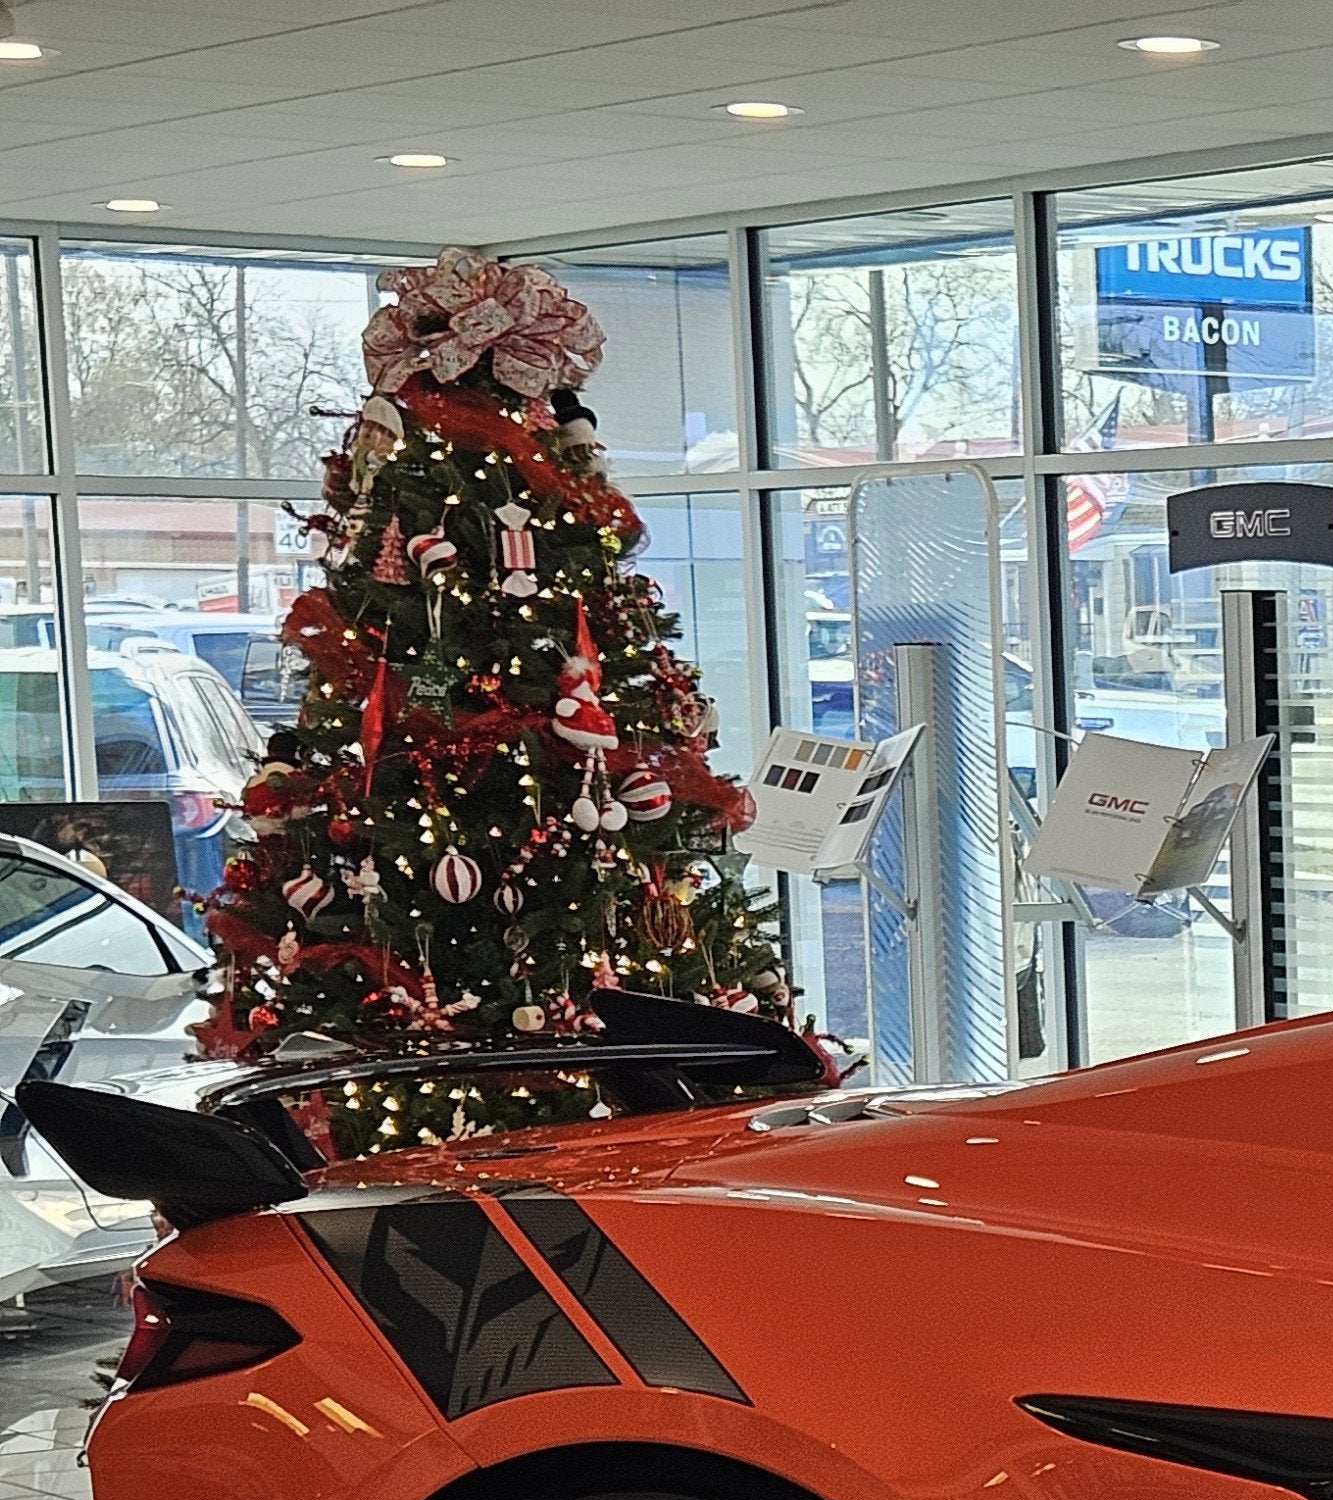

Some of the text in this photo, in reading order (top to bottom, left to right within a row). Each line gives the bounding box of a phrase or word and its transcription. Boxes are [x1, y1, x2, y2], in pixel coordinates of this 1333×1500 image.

[1126, 236, 1302, 282] TRUCKS
[1162, 315, 1260, 346] BACON
[1210, 509, 1291, 538] GMC
[279, 532, 308, 549] 40
[1088, 792, 1150, 815] GMC
